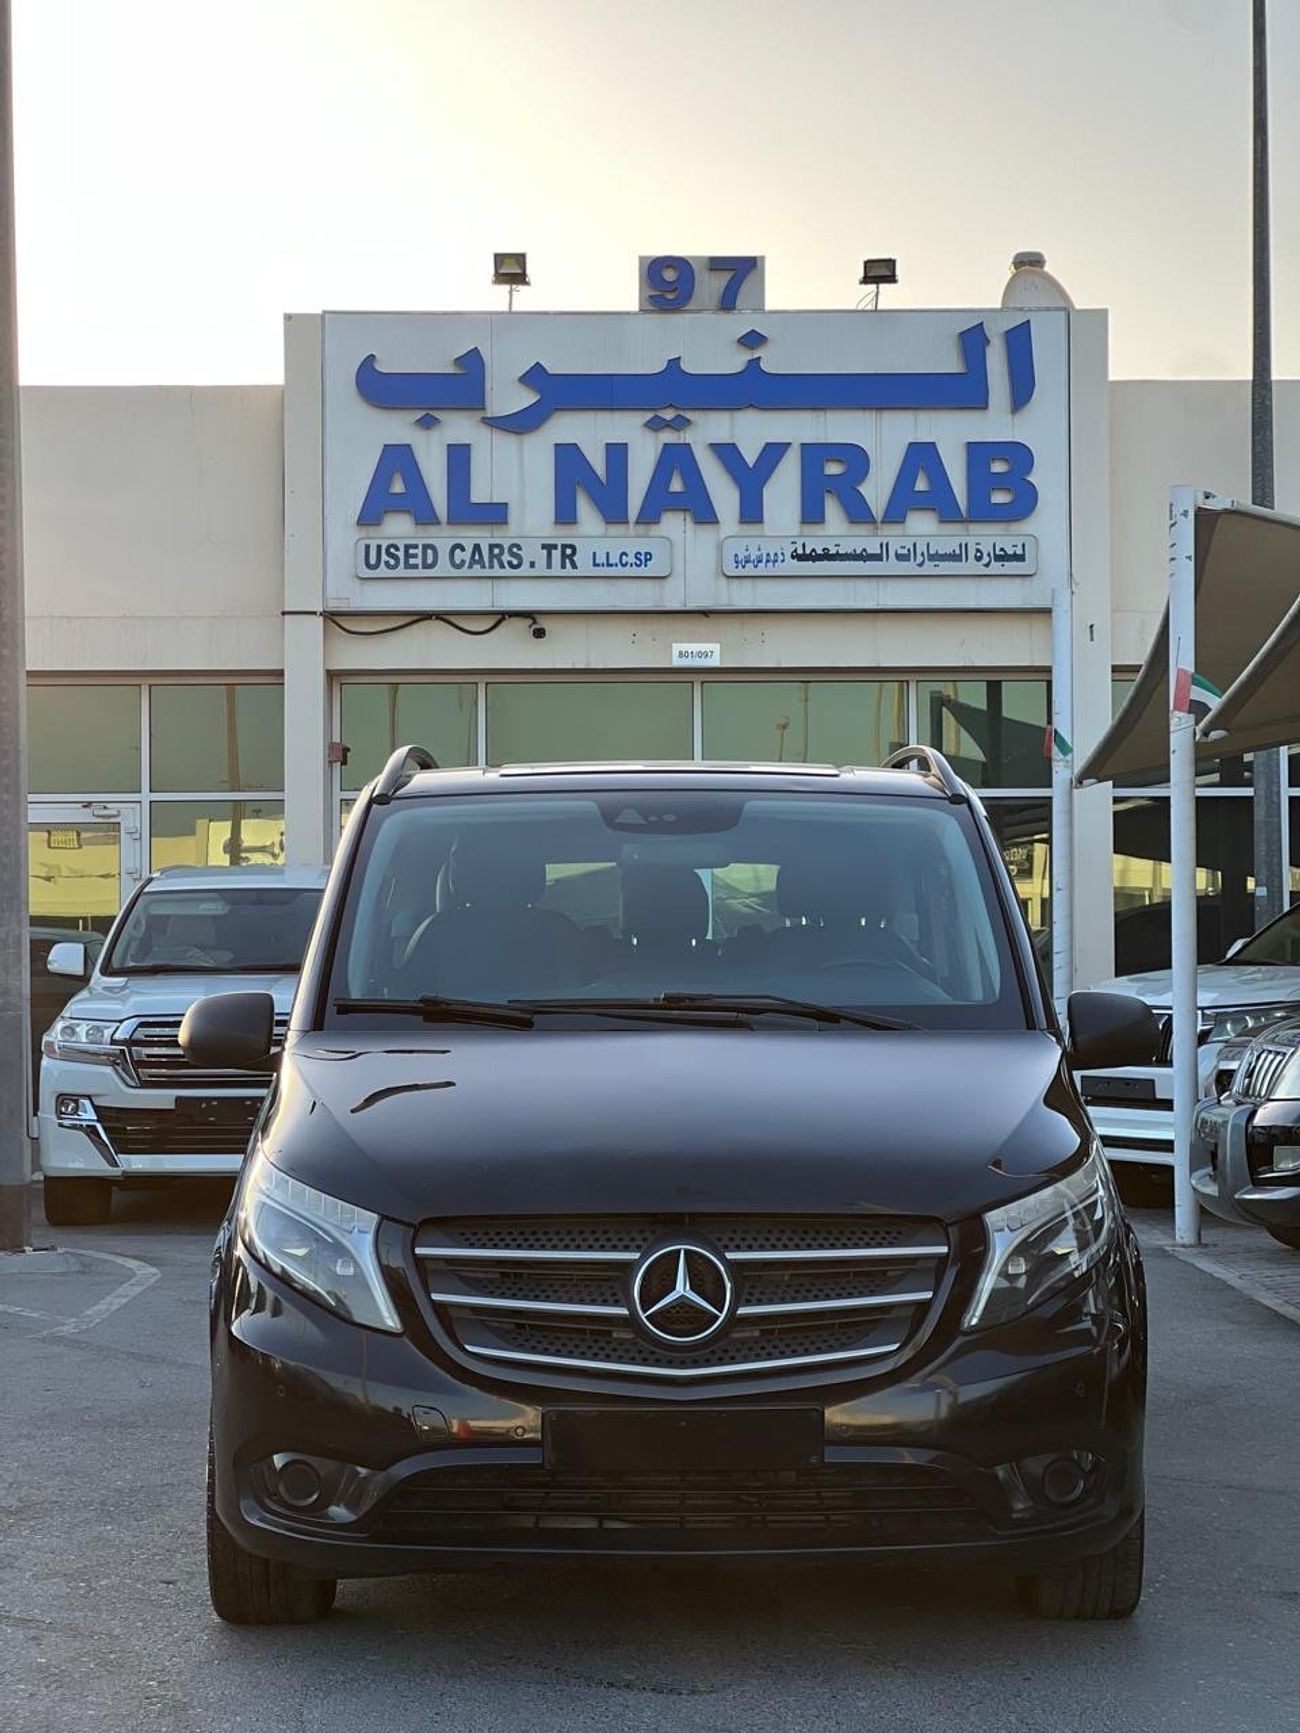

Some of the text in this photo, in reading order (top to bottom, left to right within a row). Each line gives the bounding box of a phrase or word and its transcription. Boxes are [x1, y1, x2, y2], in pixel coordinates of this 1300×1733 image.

[647, 255, 757, 311] 97
[355, 319, 1036, 434] النيرب
[356, 441, 1039, 525] AL NAYRAB
[363, 543, 439, 570] USED
[790, 541, 889, 563] المستعملة
[894, 541, 969, 568] السيارات
[974, 541, 1026, 568] لتجارة
